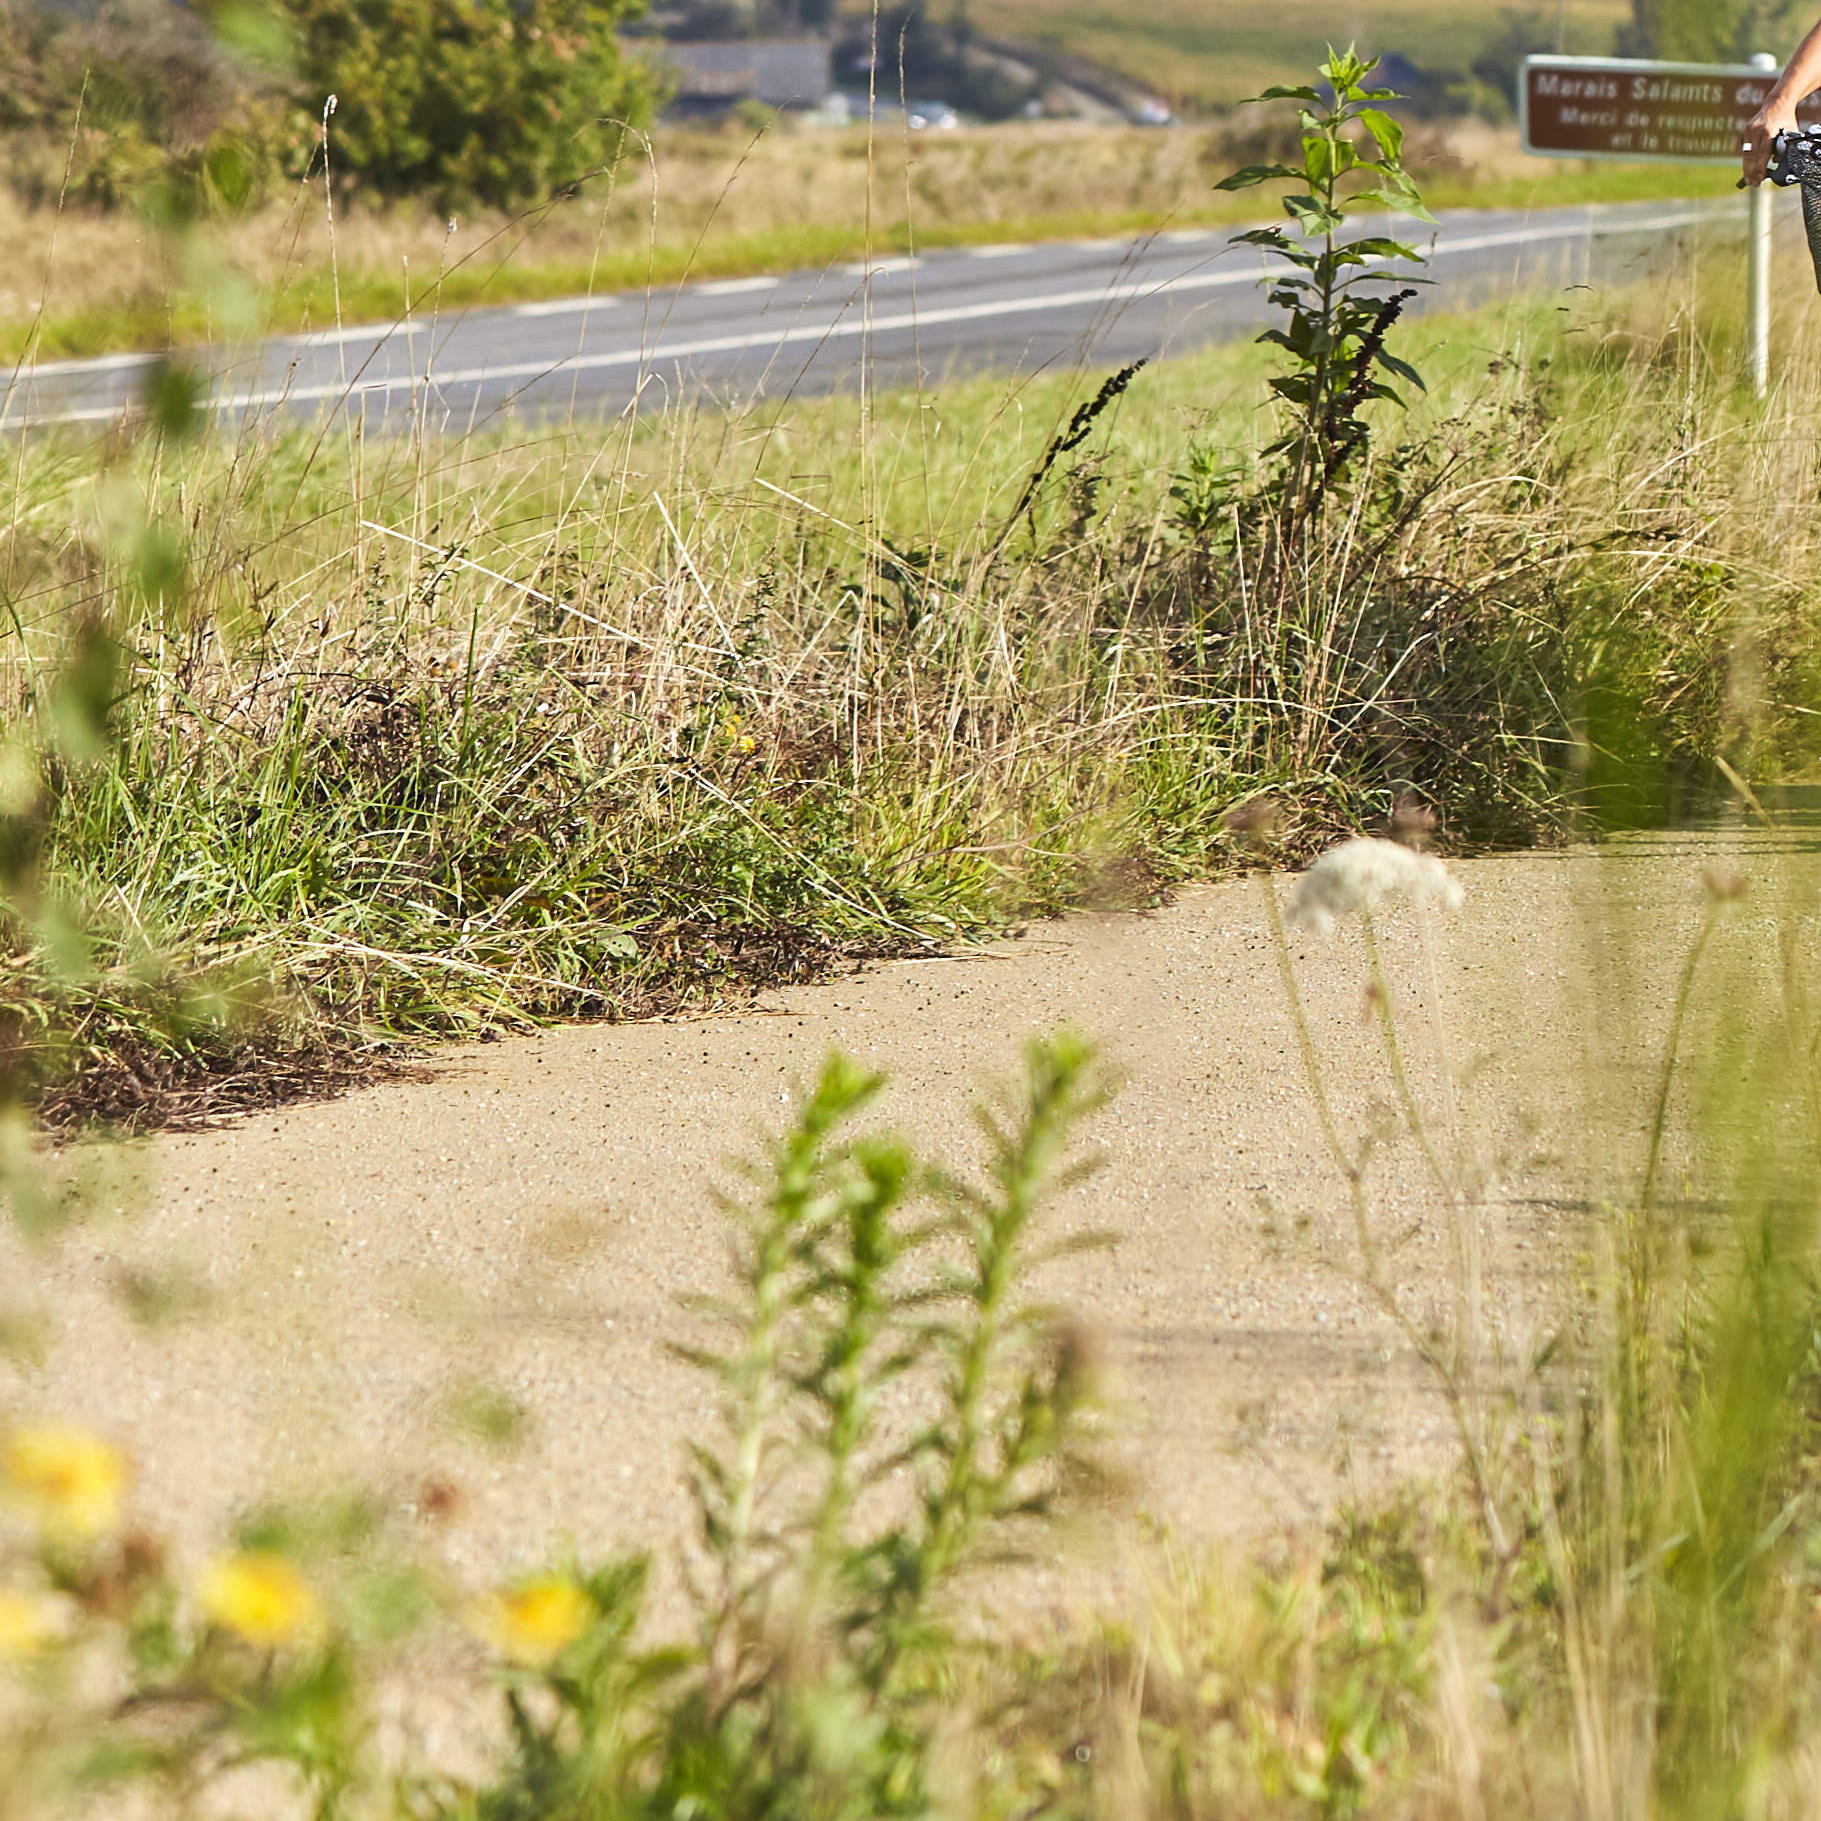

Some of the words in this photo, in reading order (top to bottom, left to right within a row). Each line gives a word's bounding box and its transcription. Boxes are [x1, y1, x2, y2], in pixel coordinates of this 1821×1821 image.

[1537, 74, 1617, 98] Marais
[1735, 81, 1764, 104] du
[1559, 107, 1617, 125] Merci
[1626, 110, 1649, 126] de
[1657, 114, 1746, 133] respecte
